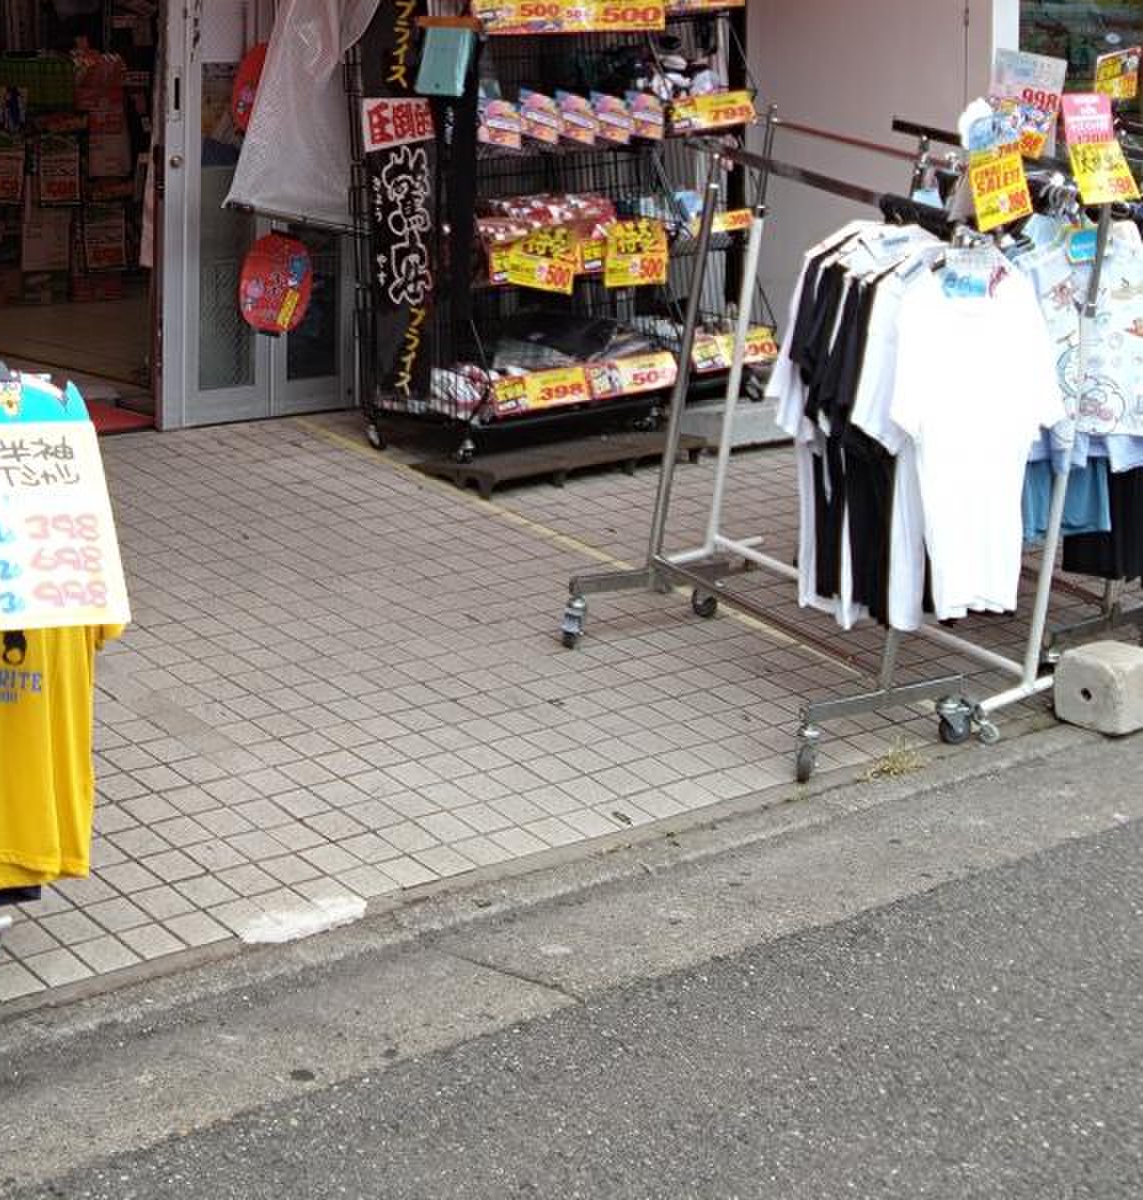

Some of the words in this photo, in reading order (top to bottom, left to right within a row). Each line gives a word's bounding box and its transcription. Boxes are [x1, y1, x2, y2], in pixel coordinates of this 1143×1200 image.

[25, 514, 99, 542] 398
[30, 546, 103, 572] 698
[33, 581, 107, 608] 998
